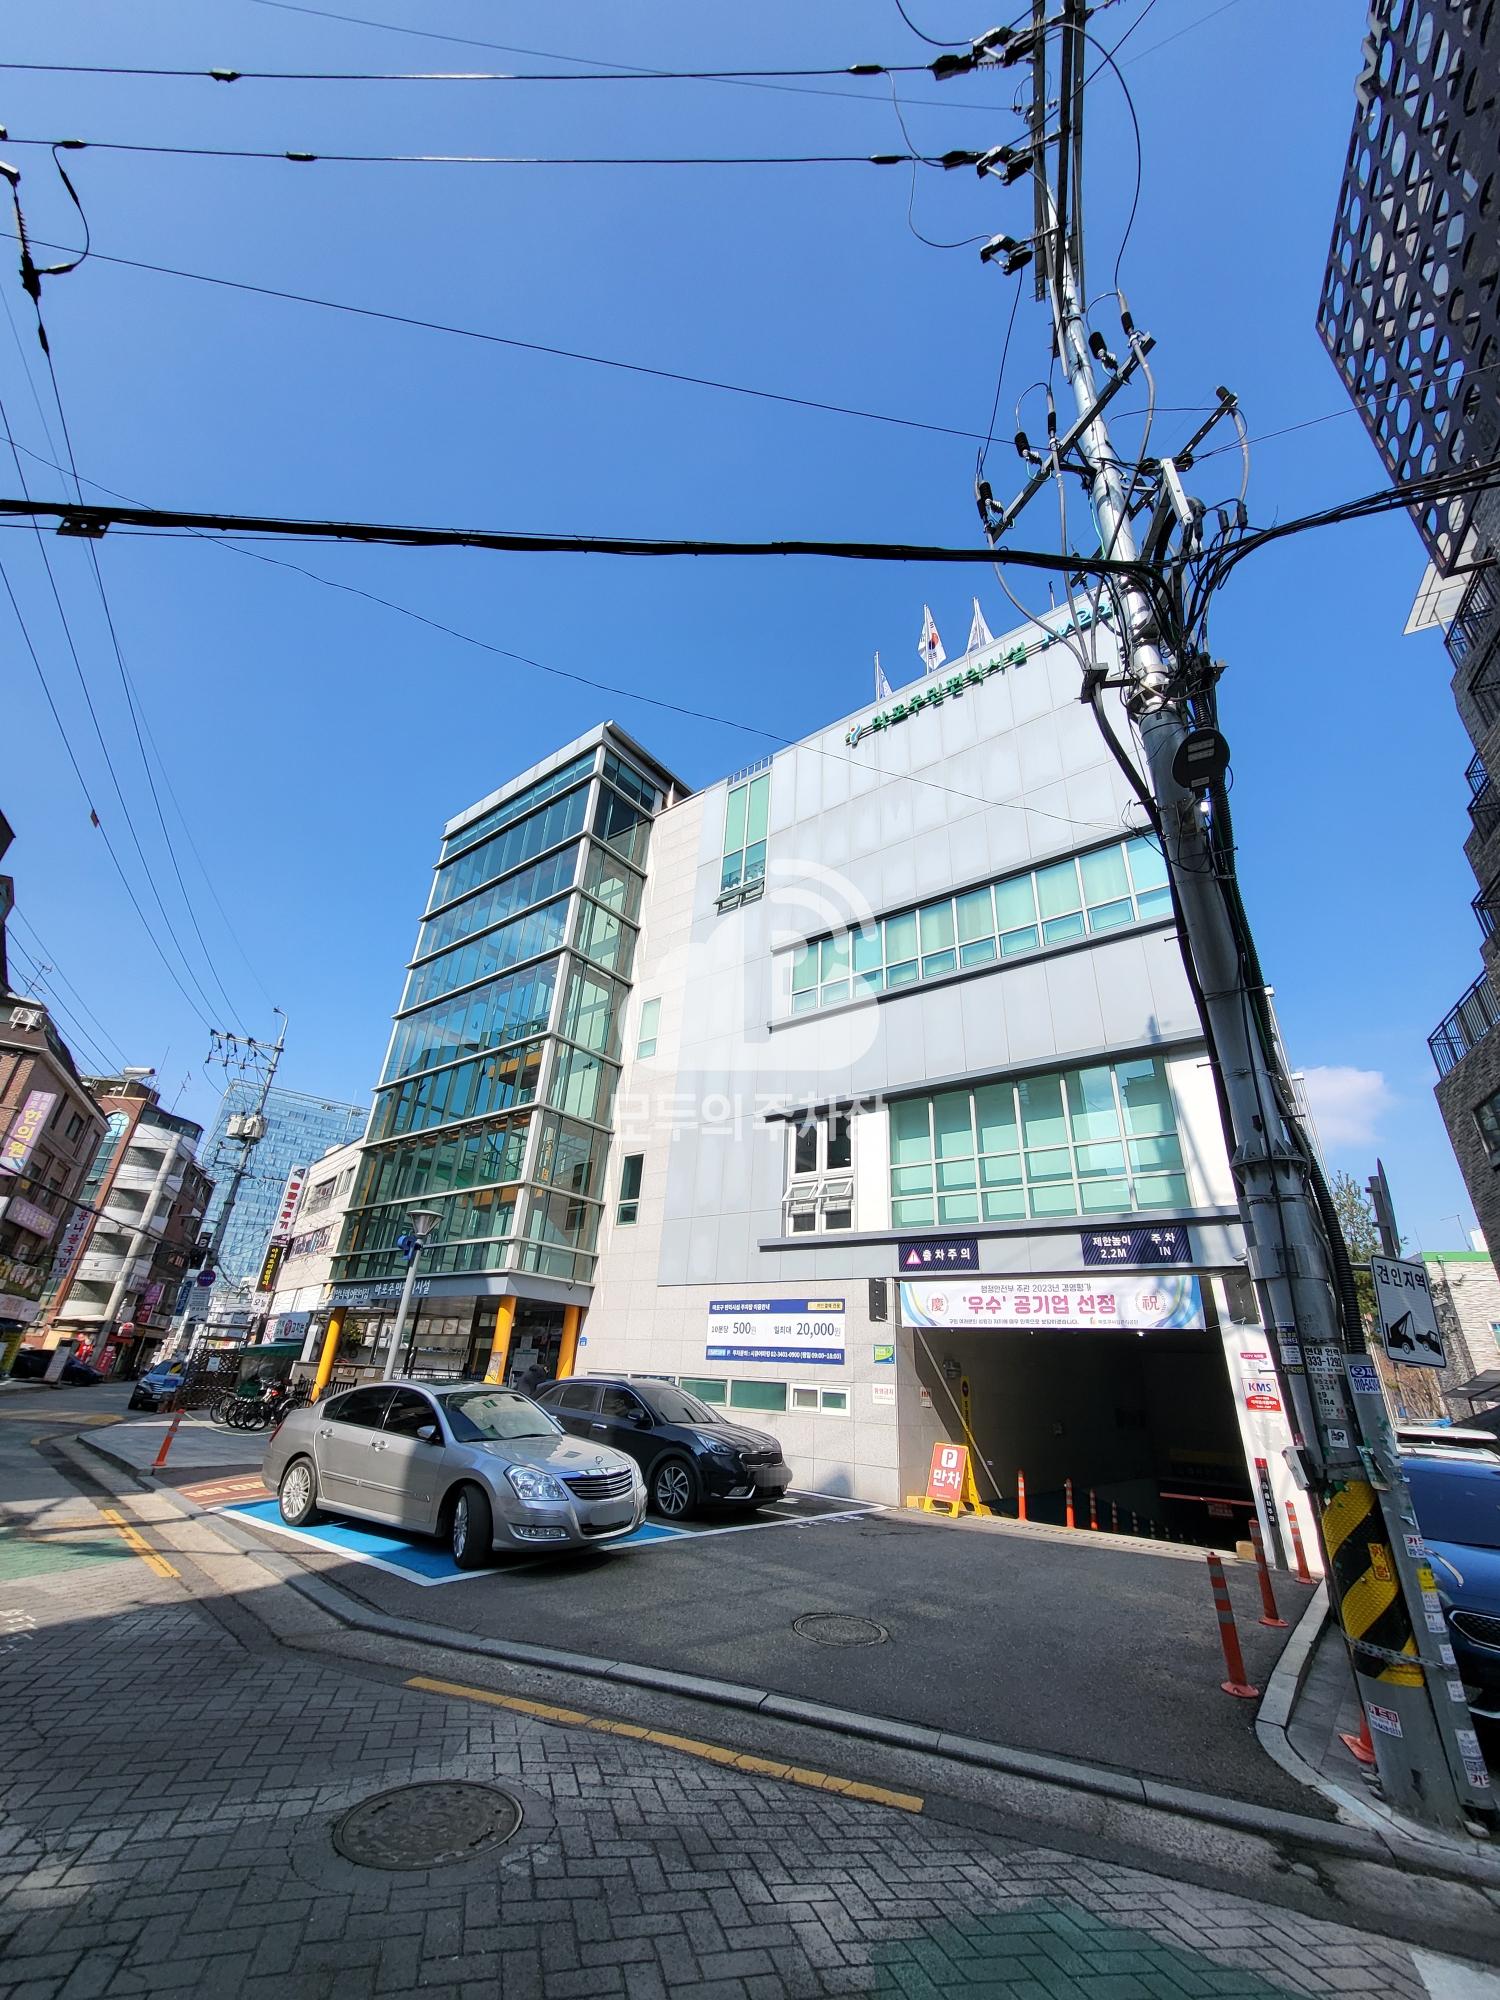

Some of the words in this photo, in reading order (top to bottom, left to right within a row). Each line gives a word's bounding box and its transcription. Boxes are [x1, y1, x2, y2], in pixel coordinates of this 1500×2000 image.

[872, 641, 1026, 734] 마포주민편의시설
[8, 1108, 43, 1159] 한의원
[1092, 1235, 1132, 1246] 제한높이
[1100, 1248, 1127, 1259] 2.2M
[1159, 1245, 1172, 1256] IN
[1376, 1263, 1428, 1293] 견인지역
[374, 1279, 431, 1296] 마포주민시설
[980, 1284, 1014, 1294] 행정안전부
[1016, 1284, 1030, 1293] 주관
[1032, 1283, 1060, 1293] 2023년
[1061, 1282, 1092, 1292] 경영평가
[930, 1296, 945, 1312] 慶
[962, 1295, 1007, 1315] '우수'
[1013, 1294, 1070, 1315] 공기업
[1077, 1294, 1117, 1315] 선정
[1141, 1295, 1160, 1311] 祝
[711, 1325, 729, 1334] 10분당
[1248, 1382, 1272, 1392] KMS
[933, 1468, 961, 1490] 만차
